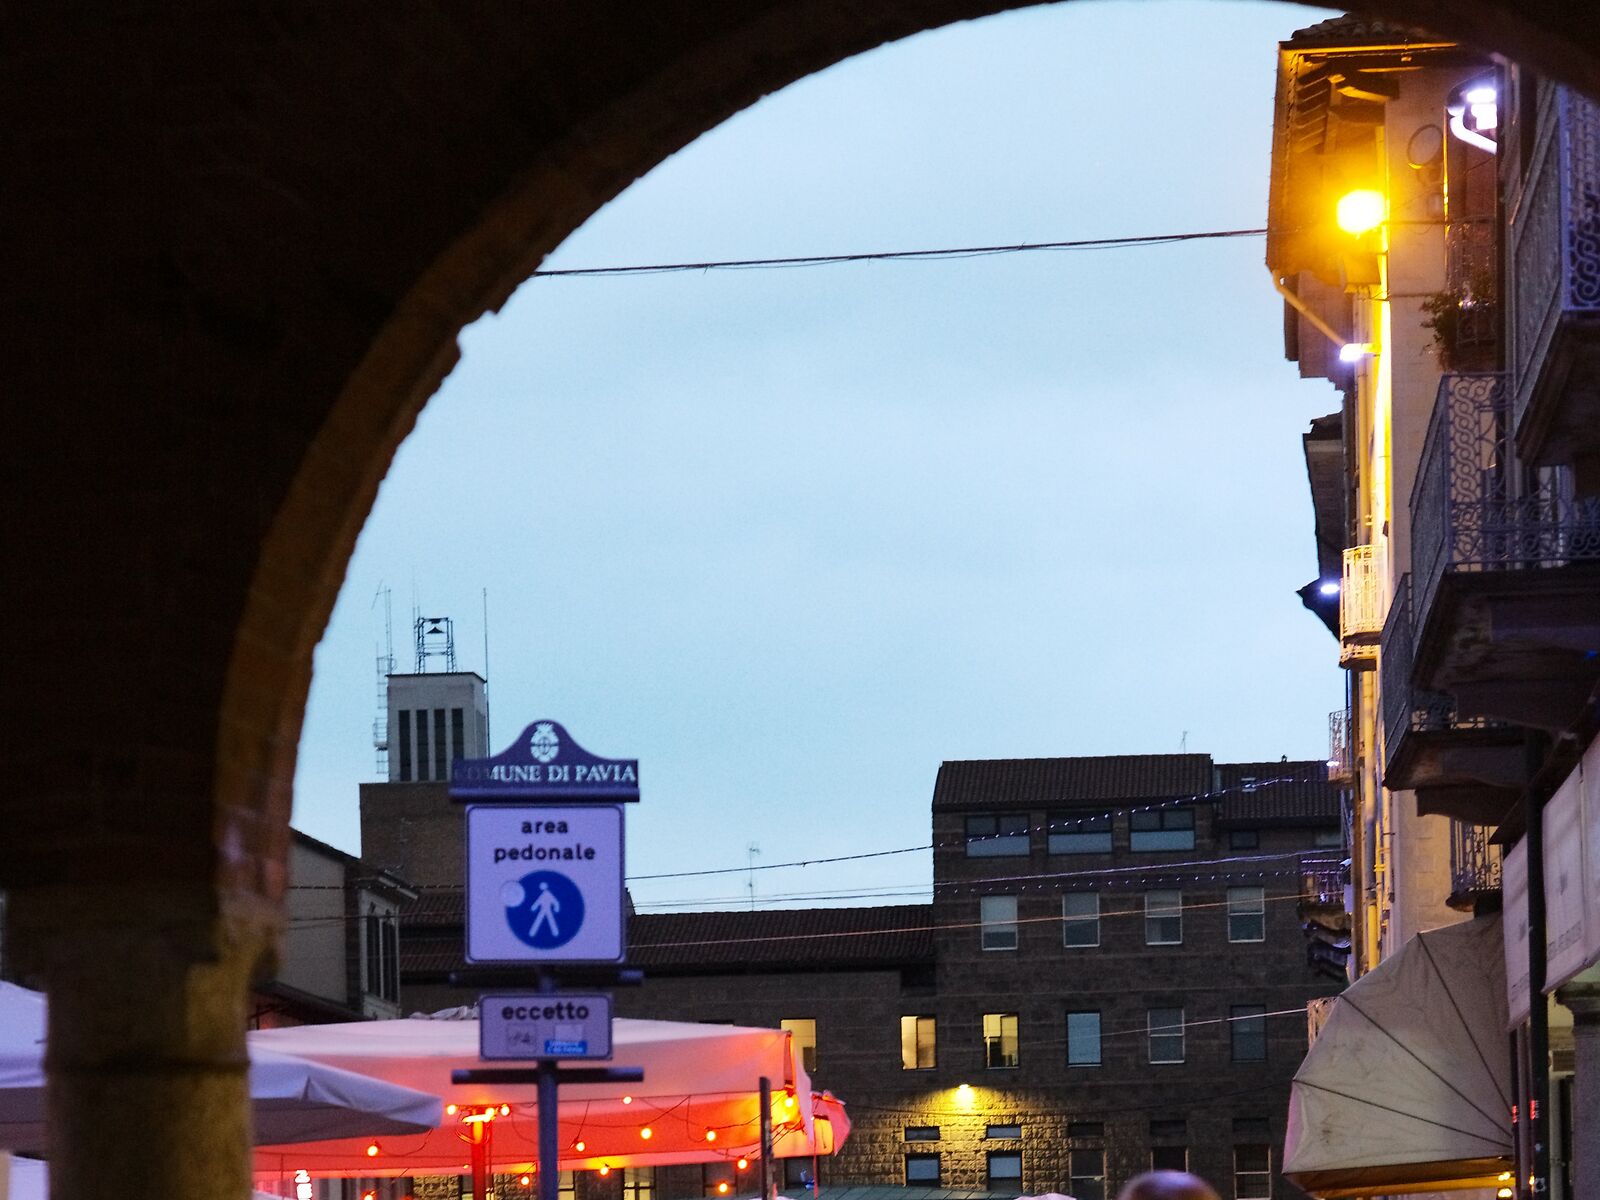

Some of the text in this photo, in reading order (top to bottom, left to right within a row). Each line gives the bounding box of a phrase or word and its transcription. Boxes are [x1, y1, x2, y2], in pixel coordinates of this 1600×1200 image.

[548, 765, 569, 782] DI
[575, 765, 636, 782] PAVIA
[521, 821, 568, 834] area
[494, 843, 596, 864] pedonale
[502, 1002, 589, 1020] eccetto
